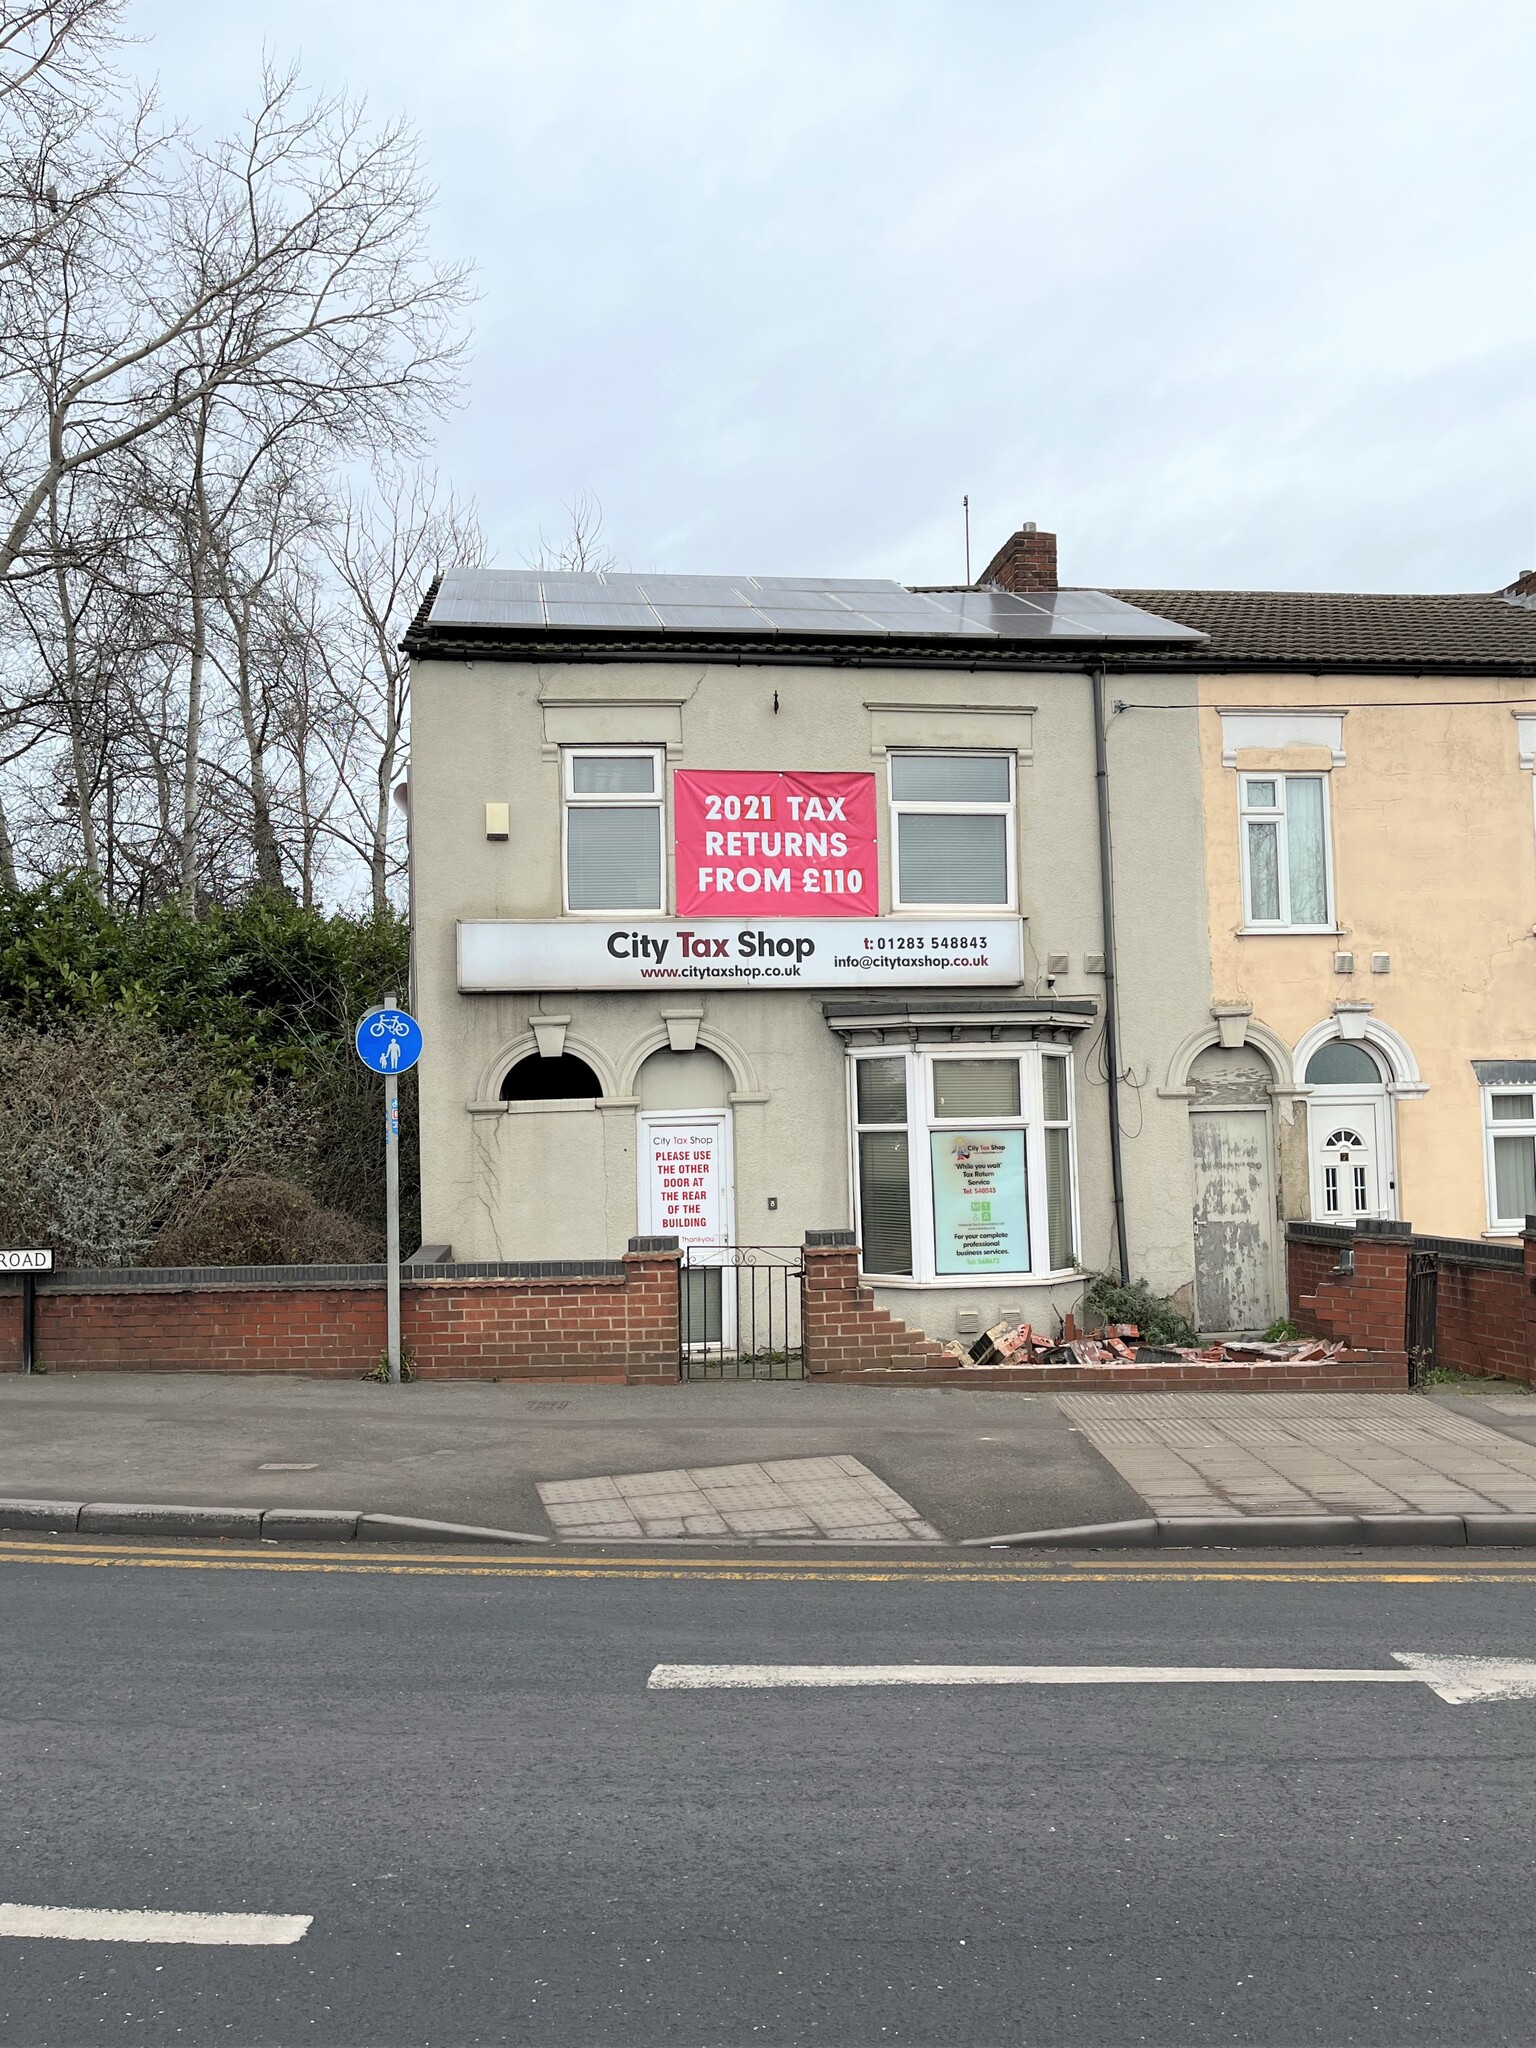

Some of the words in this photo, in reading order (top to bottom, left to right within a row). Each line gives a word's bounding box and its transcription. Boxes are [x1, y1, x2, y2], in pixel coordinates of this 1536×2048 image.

[704, 794, 772, 821] 2021
[786, 796, 848, 822] TAX
[705, 831, 849, 857] RETURNS
[698, 867, 791, 893] FROM
[801, 867, 863, 894] £110
[606, 931, 670, 965] City
[676, 931, 731, 958] Tax
[737, 930, 816, 964] Shop
[863, 937, 874, 950] t:
[877, 937, 925, 950] 01283
[931, 936, 988, 949] 548843
[834, 954, 989, 970] info@citytaxshop.co.uk
[640, 964, 801, 980] www.citytaxshop.co.uk
[653, 1136, 671, 1146] City
[673, 1136, 688, 1145] Tax
[690, 1136, 713, 1146] Shop
[967, 1144, 979, 1152] City
[655, 1151, 690, 1161] PLEASE
[693, 1151, 711, 1160] USE
[657, 1165, 675, 1174] THE
[678, 1164, 709, 1174] OTHER
[663, 1178, 690, 1188] DOOR
[692, 1177, 704, 1187] AT
[661, 1191, 679, 1201] THE
[682, 1190, 707, 1200] REAR
[667, 1205, 680, 1214] OF
[682, 1204, 701, 1214] THE
[662, 1218, 707, 1228] BUILDING
[963, 1240, 1000, 1248] professional
[983, 1248, 1010, 1256] services.
[0, 1253, 46, 1267] ROAD
